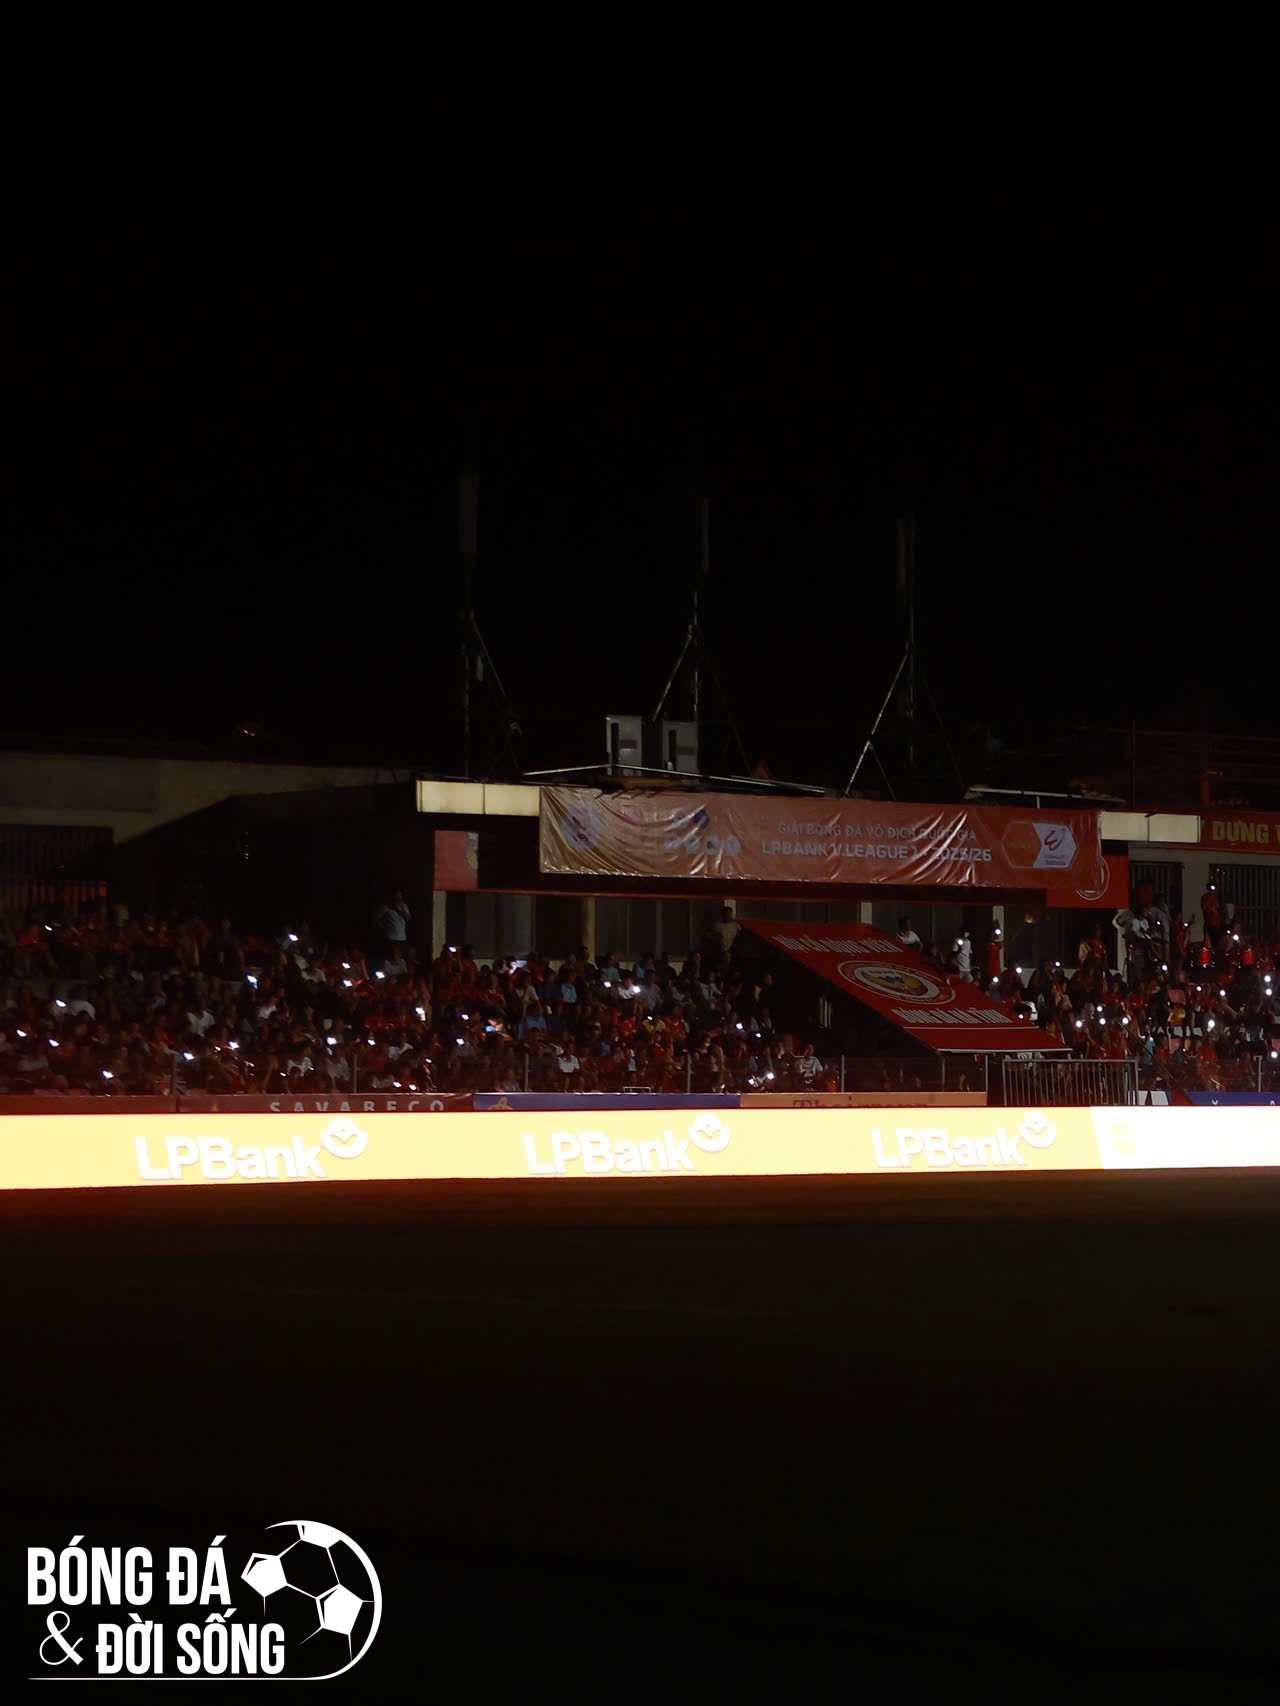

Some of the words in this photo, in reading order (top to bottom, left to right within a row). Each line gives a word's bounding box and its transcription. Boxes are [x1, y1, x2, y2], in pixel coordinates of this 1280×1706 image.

[762, 839, 829, 857] LPBANK
[830, 842, 909, 859] V.LEAGUE
[1212, 820, 1270, 847] DỰNG
[134, 1135, 324, 1180] LPBank
[523, 1130, 695, 1175] LPBank
[872, 1128, 1028, 1168] LPBank
